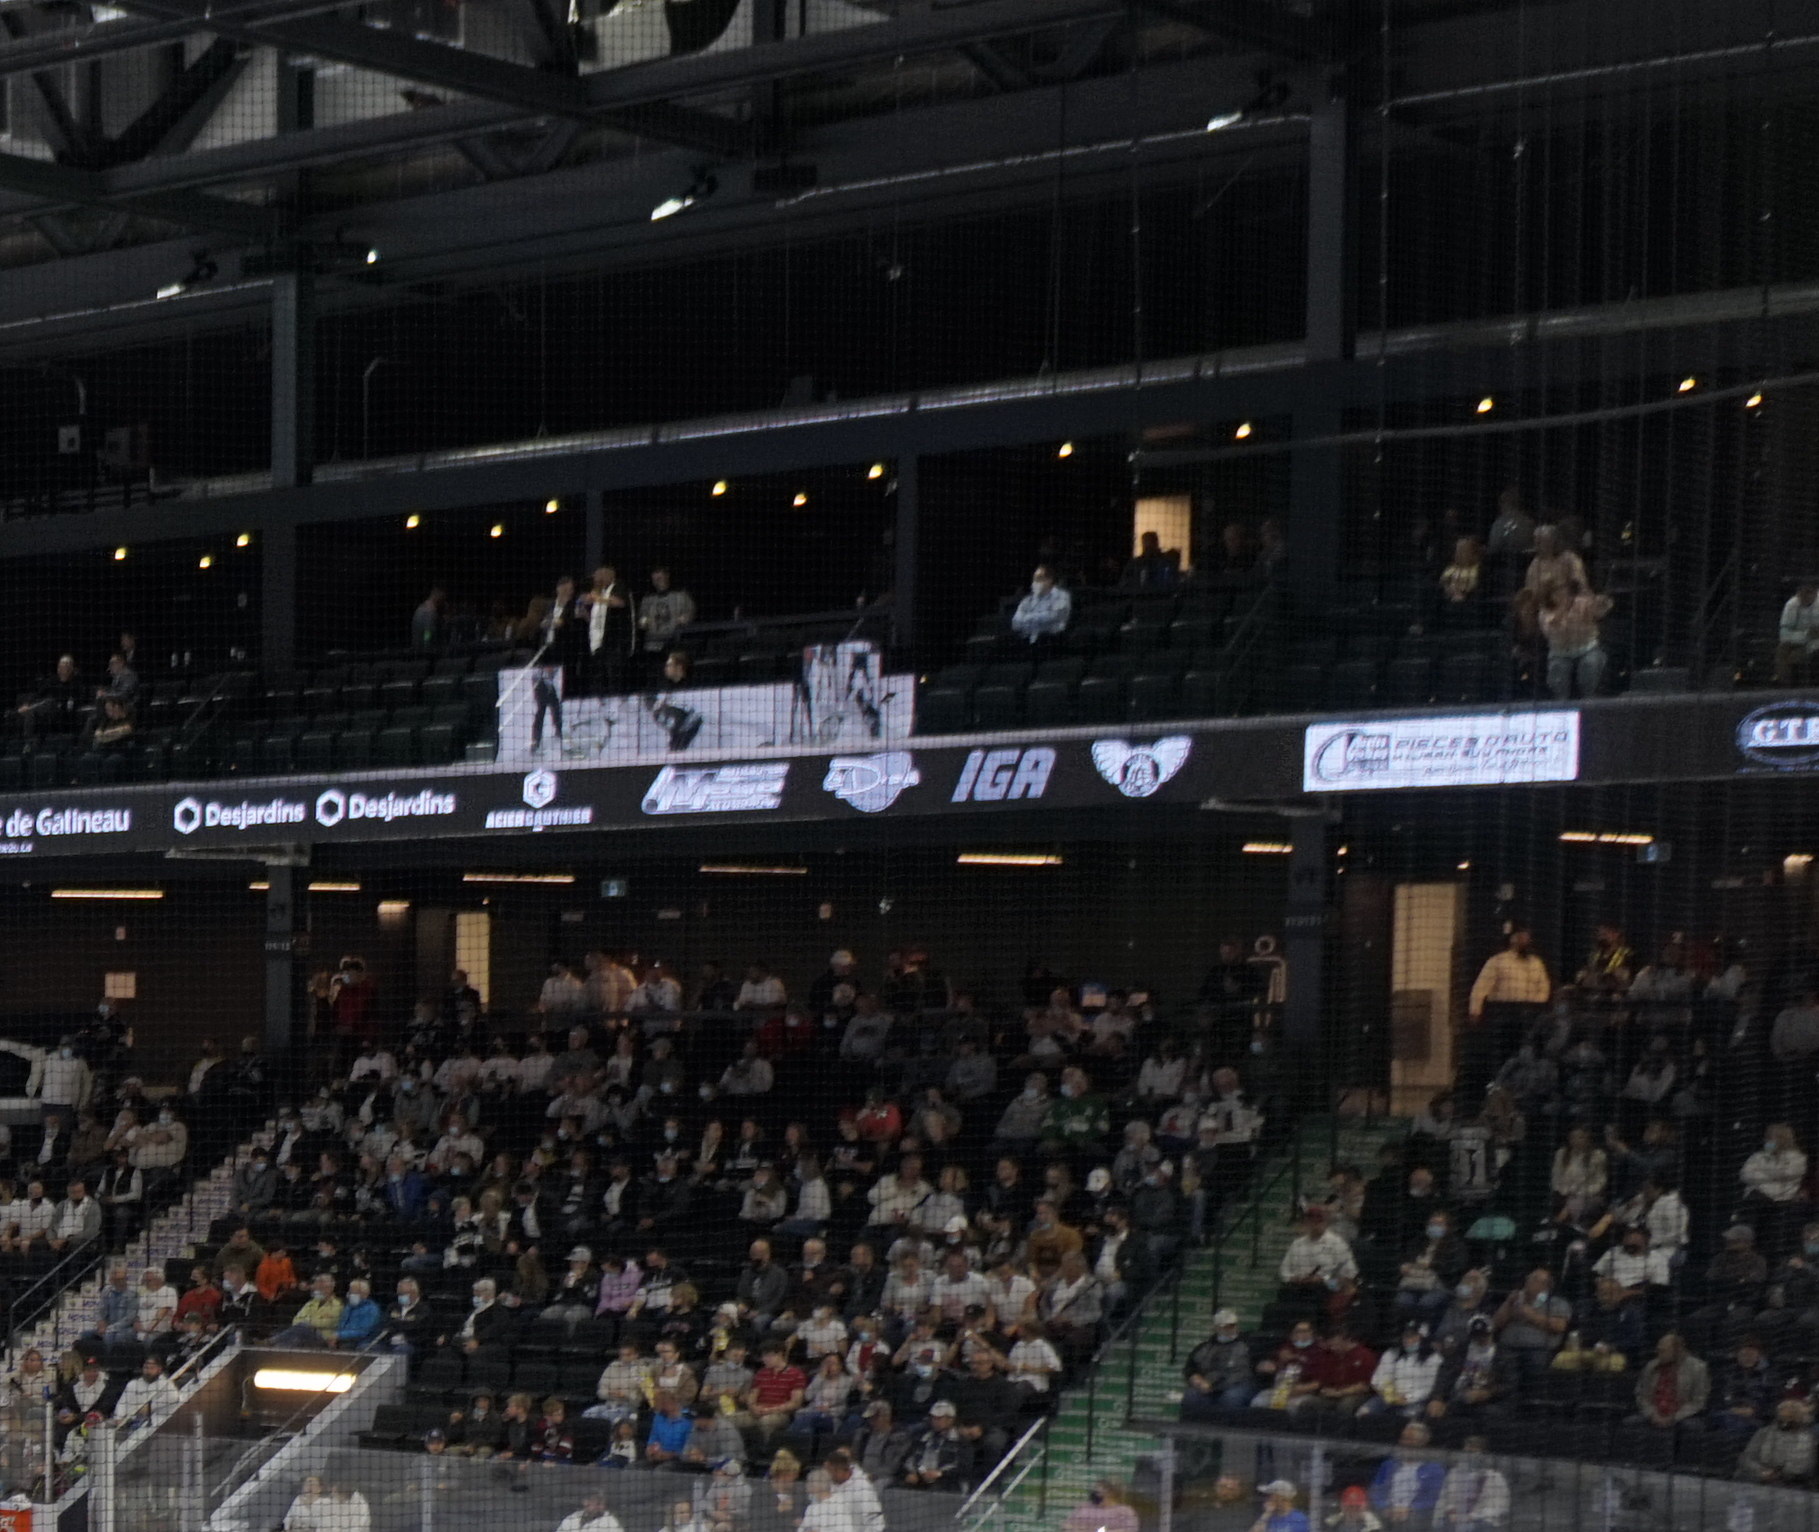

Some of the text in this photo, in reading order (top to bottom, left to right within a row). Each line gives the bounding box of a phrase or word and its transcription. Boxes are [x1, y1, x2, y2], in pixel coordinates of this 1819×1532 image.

[952, 746, 1057, 802] IGA
[205, 800, 305, 830] Desjardins
[347, 792, 456, 822] Desjardins
[6, 808, 34, 838] de
[36, 807, 131, 837] Gatineau
